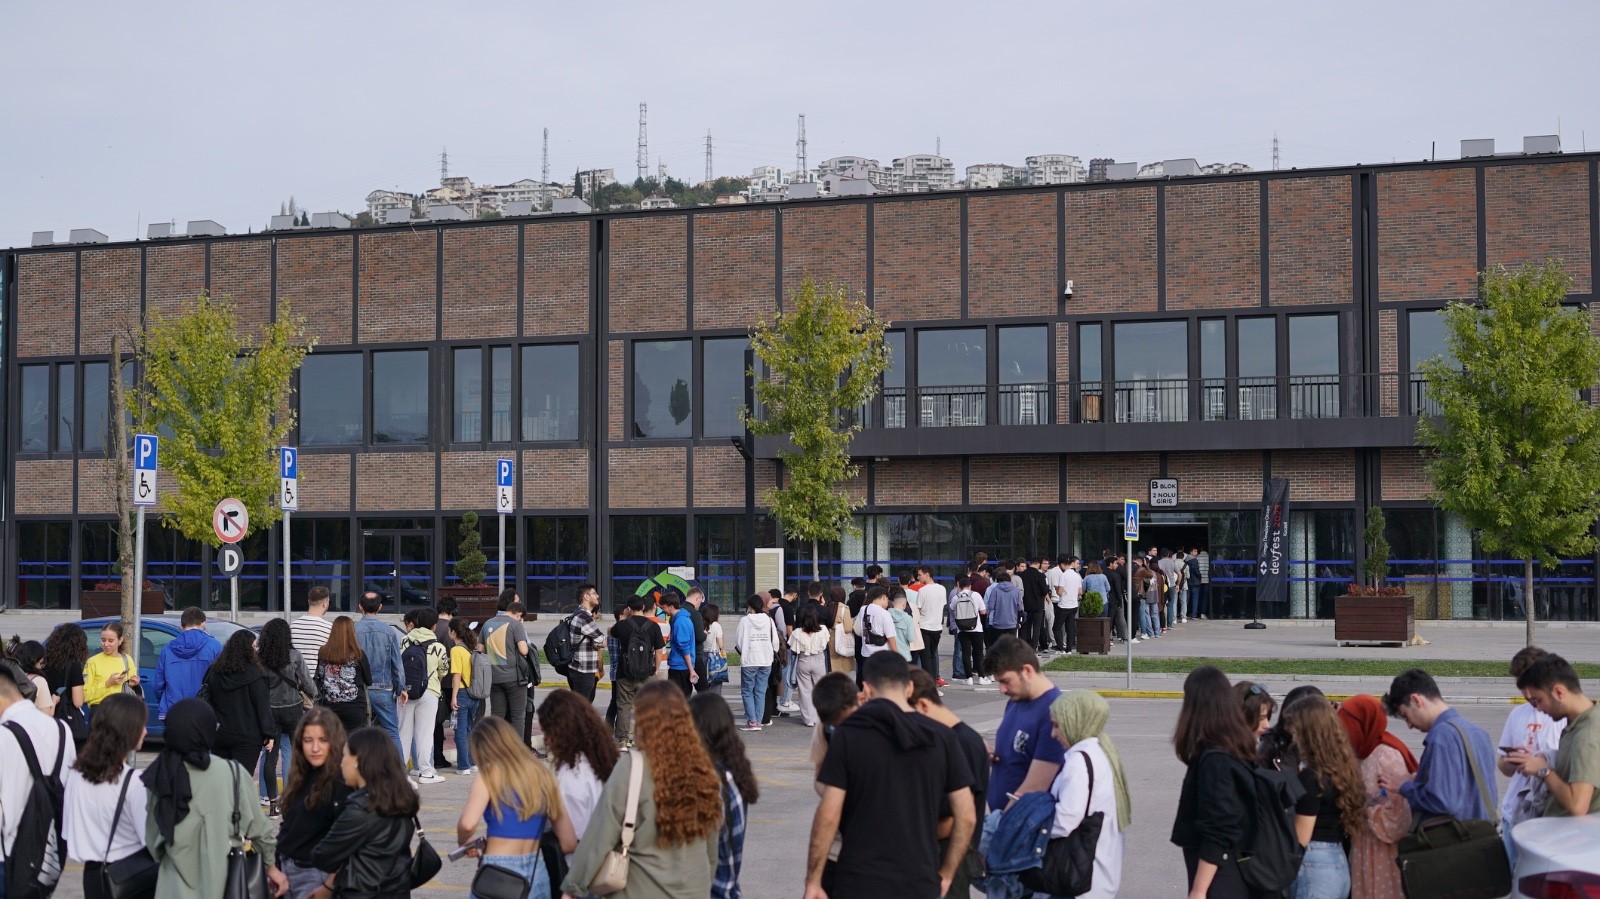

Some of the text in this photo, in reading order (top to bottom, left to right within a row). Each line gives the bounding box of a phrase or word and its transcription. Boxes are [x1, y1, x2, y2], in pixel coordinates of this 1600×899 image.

[140, 438, 152, 467] P
[285, 450, 293, 476] P
[502, 462, 509, 484] P
[1152, 481, 1158, 489] B
[224, 549, 239, 572] D
[1270, 530, 1282, 574] devfest
